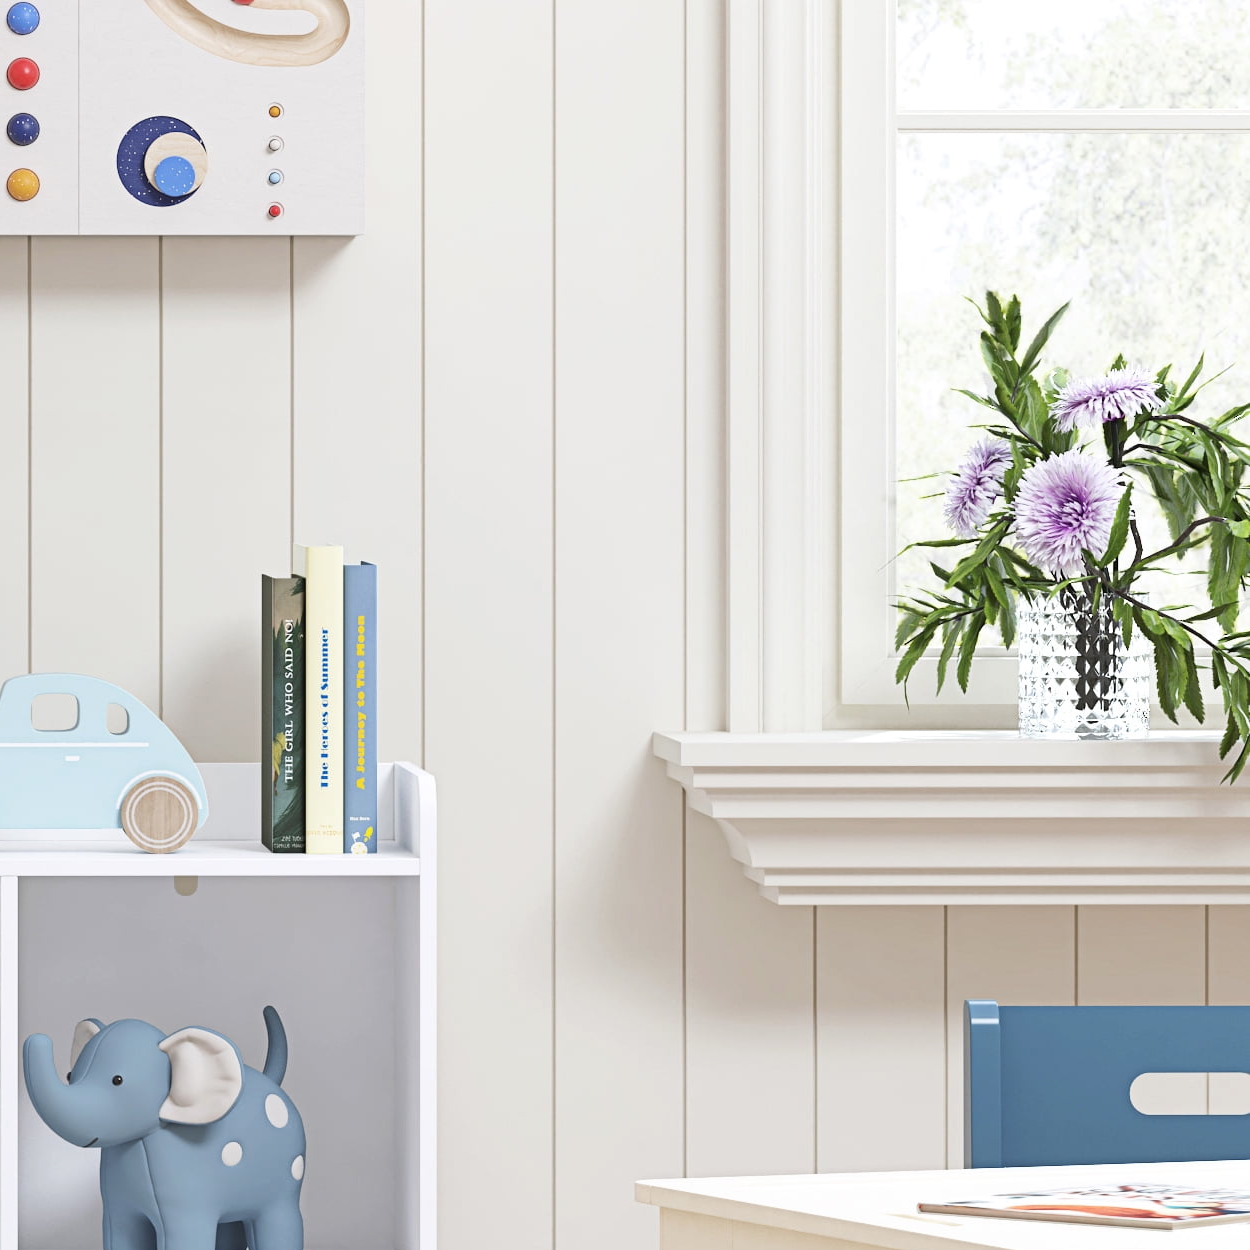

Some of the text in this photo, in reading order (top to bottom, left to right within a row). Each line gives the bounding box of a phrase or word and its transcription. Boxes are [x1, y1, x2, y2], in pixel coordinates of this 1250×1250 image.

[284, 619, 294, 783] THE GIRL WHO SAID NO!
[320, 627, 329, 788] The Heroes of Summer
[355, 615, 367, 790] A Journey to The Moon
